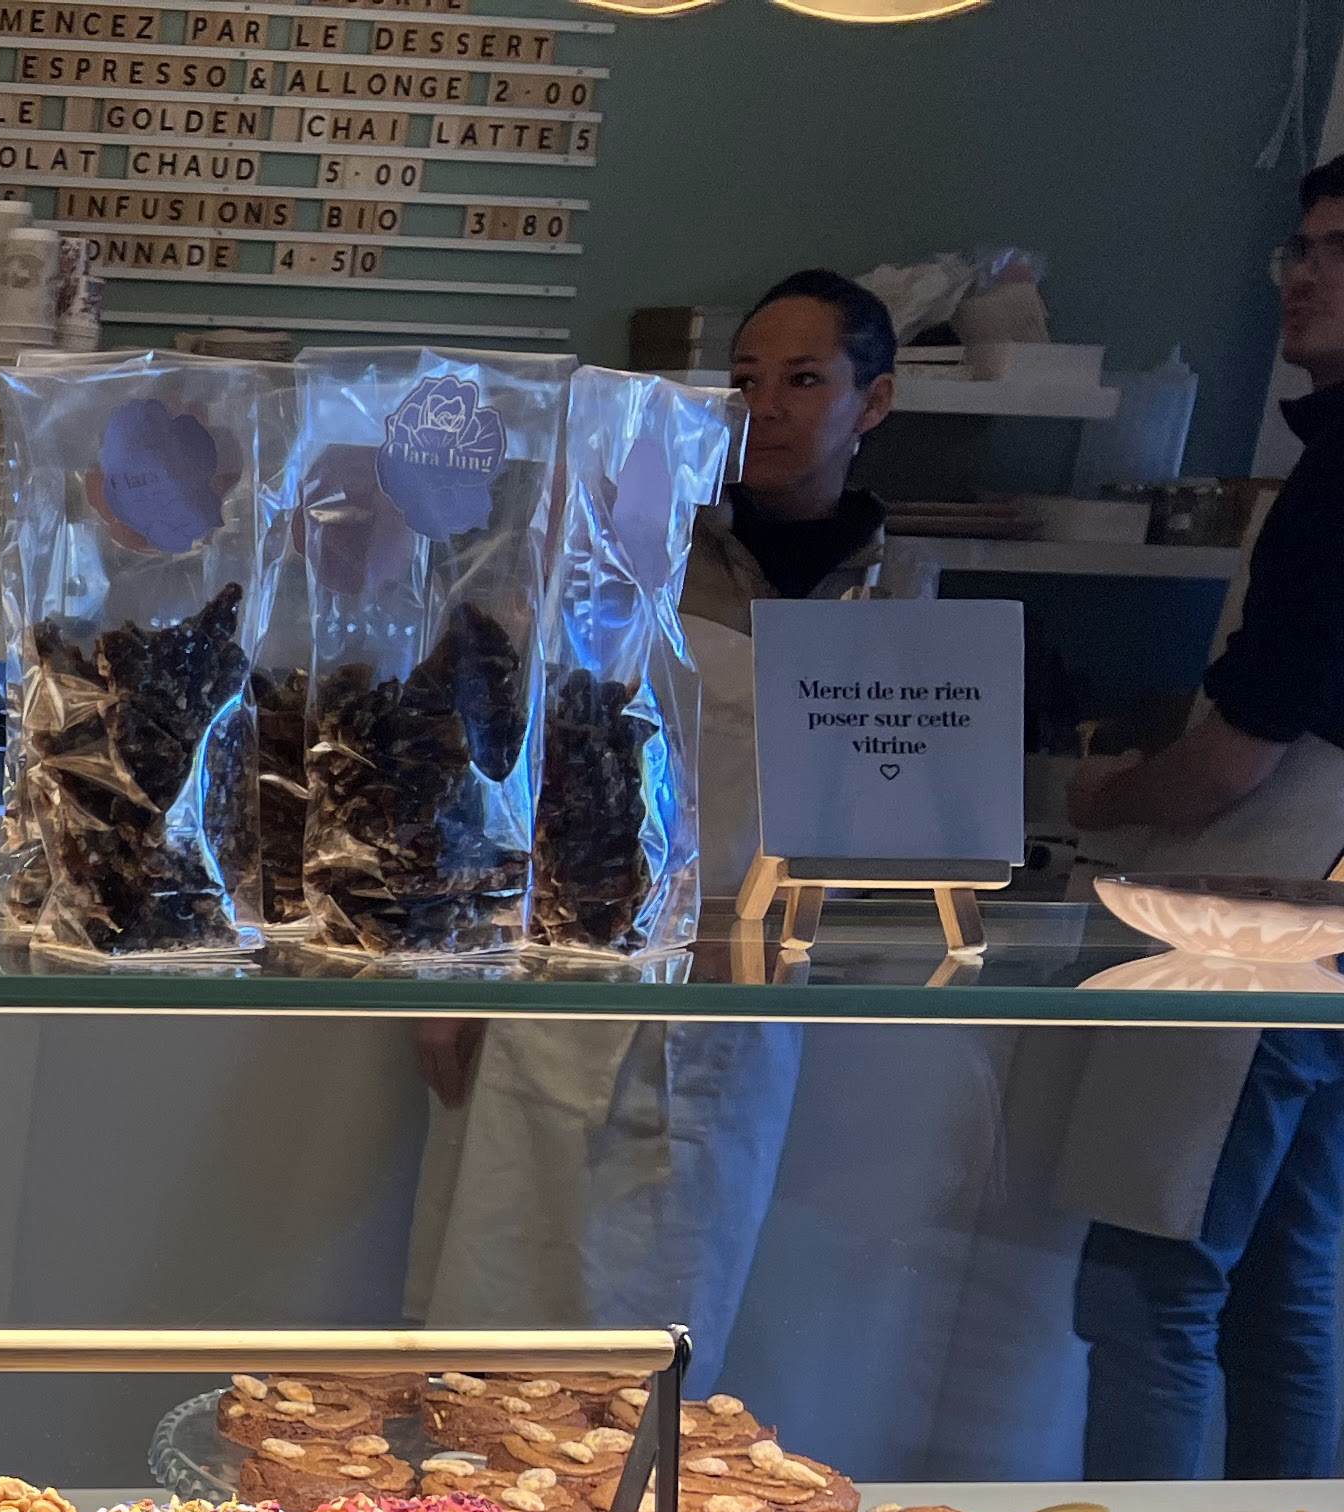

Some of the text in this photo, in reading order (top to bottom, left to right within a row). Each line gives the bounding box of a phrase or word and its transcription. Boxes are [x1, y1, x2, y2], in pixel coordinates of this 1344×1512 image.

[191, 17, 260, 44] PAR
[296, 23, 338, 49] LE
[375, 27, 550, 61] DESSERT
[21, 55, 226, 88] ESPRESSO
[250, 66, 267, 90] &
[288, 67, 463, 101] ALLONGE
[107, 105, 257, 137] GOLDEN
[307, 115, 398, 141] CHAI
[437, 121, 554, 149] LATTE
[576, 129, 591, 151] 5
[132, 152, 254, 181] CHAUD
[67, 194, 287, 226] INFUSIONS
[327, 207, 397, 231] BIO
[448, 448, 493, 473] Jung
[798, 679, 981, 700] Merci de ne rien
[808, 711, 970, 730] poser sur cette
[852, 736, 927, 754] vitrine
